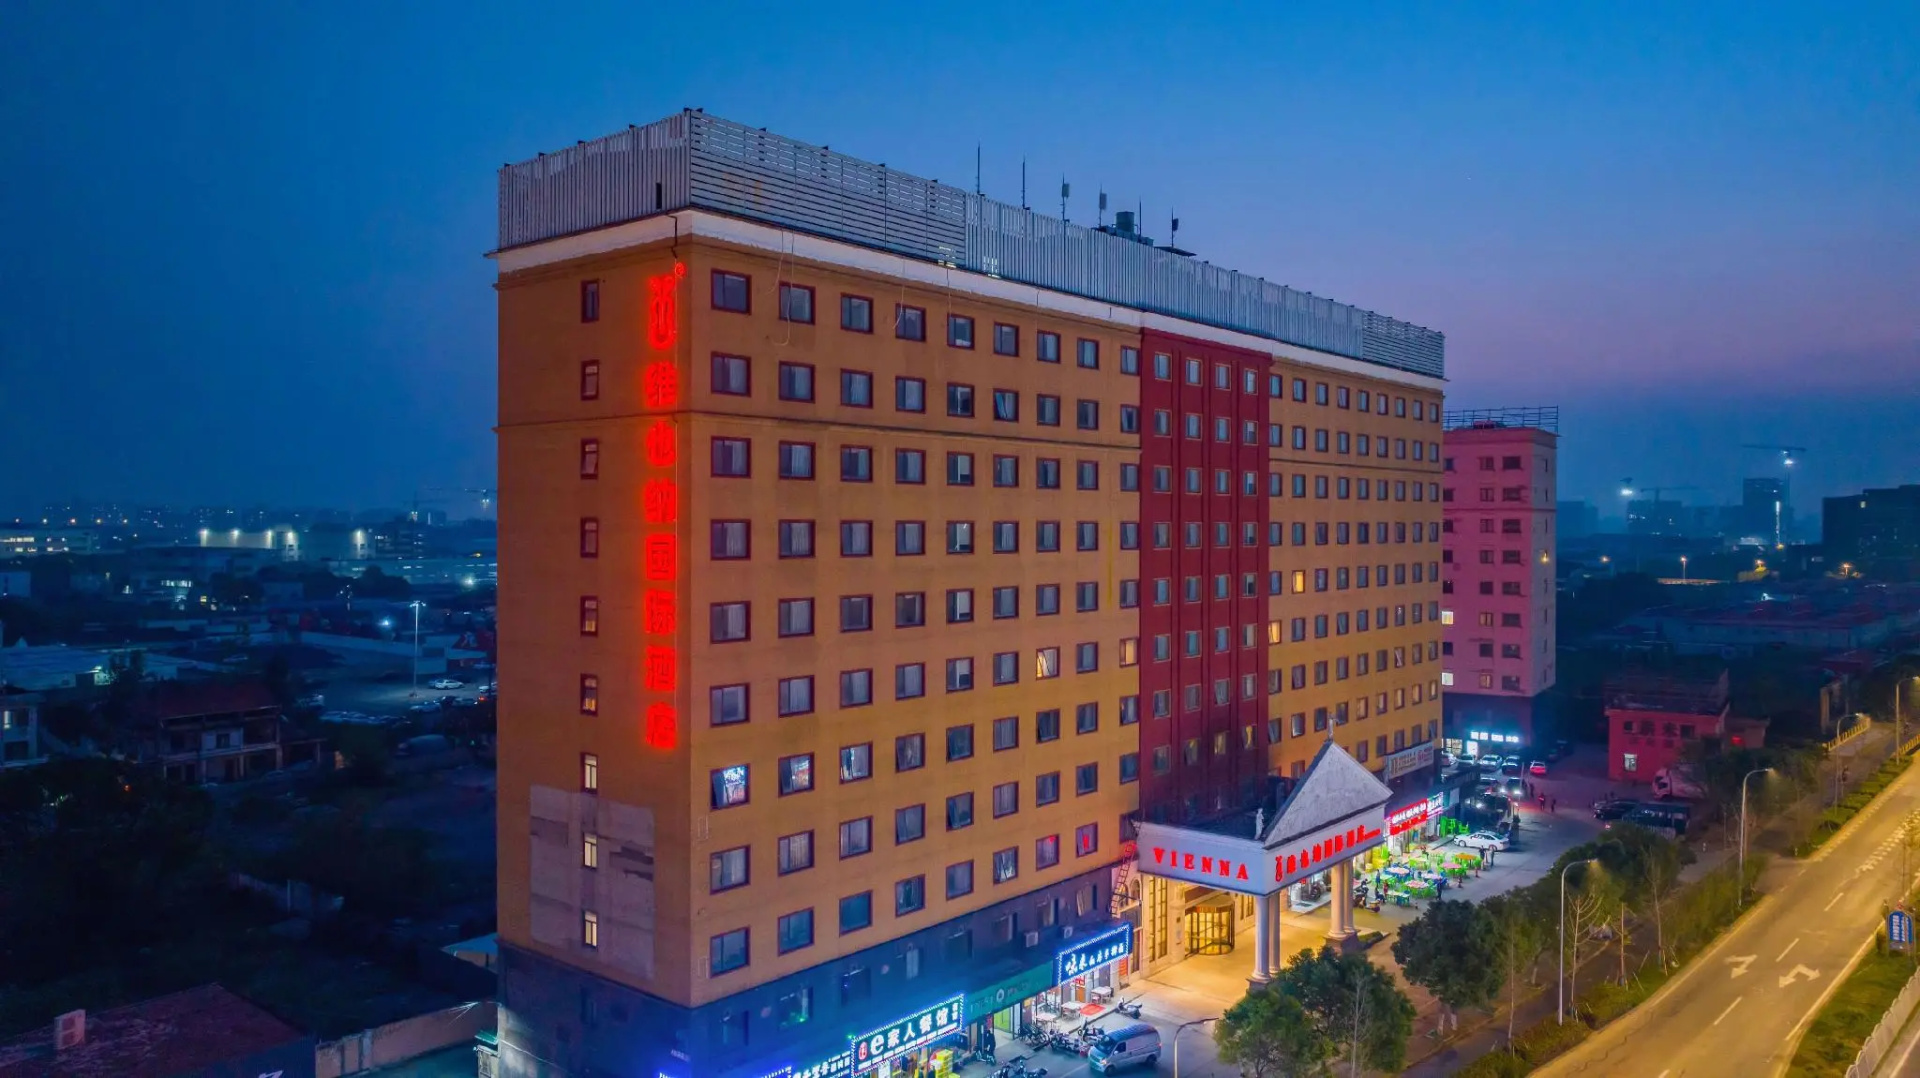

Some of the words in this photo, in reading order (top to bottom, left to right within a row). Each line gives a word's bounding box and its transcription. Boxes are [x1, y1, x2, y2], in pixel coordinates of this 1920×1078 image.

[644, 362, 677, 749] 维也纳国际酒店
[1153, 847, 1248, 880] VIENNA
